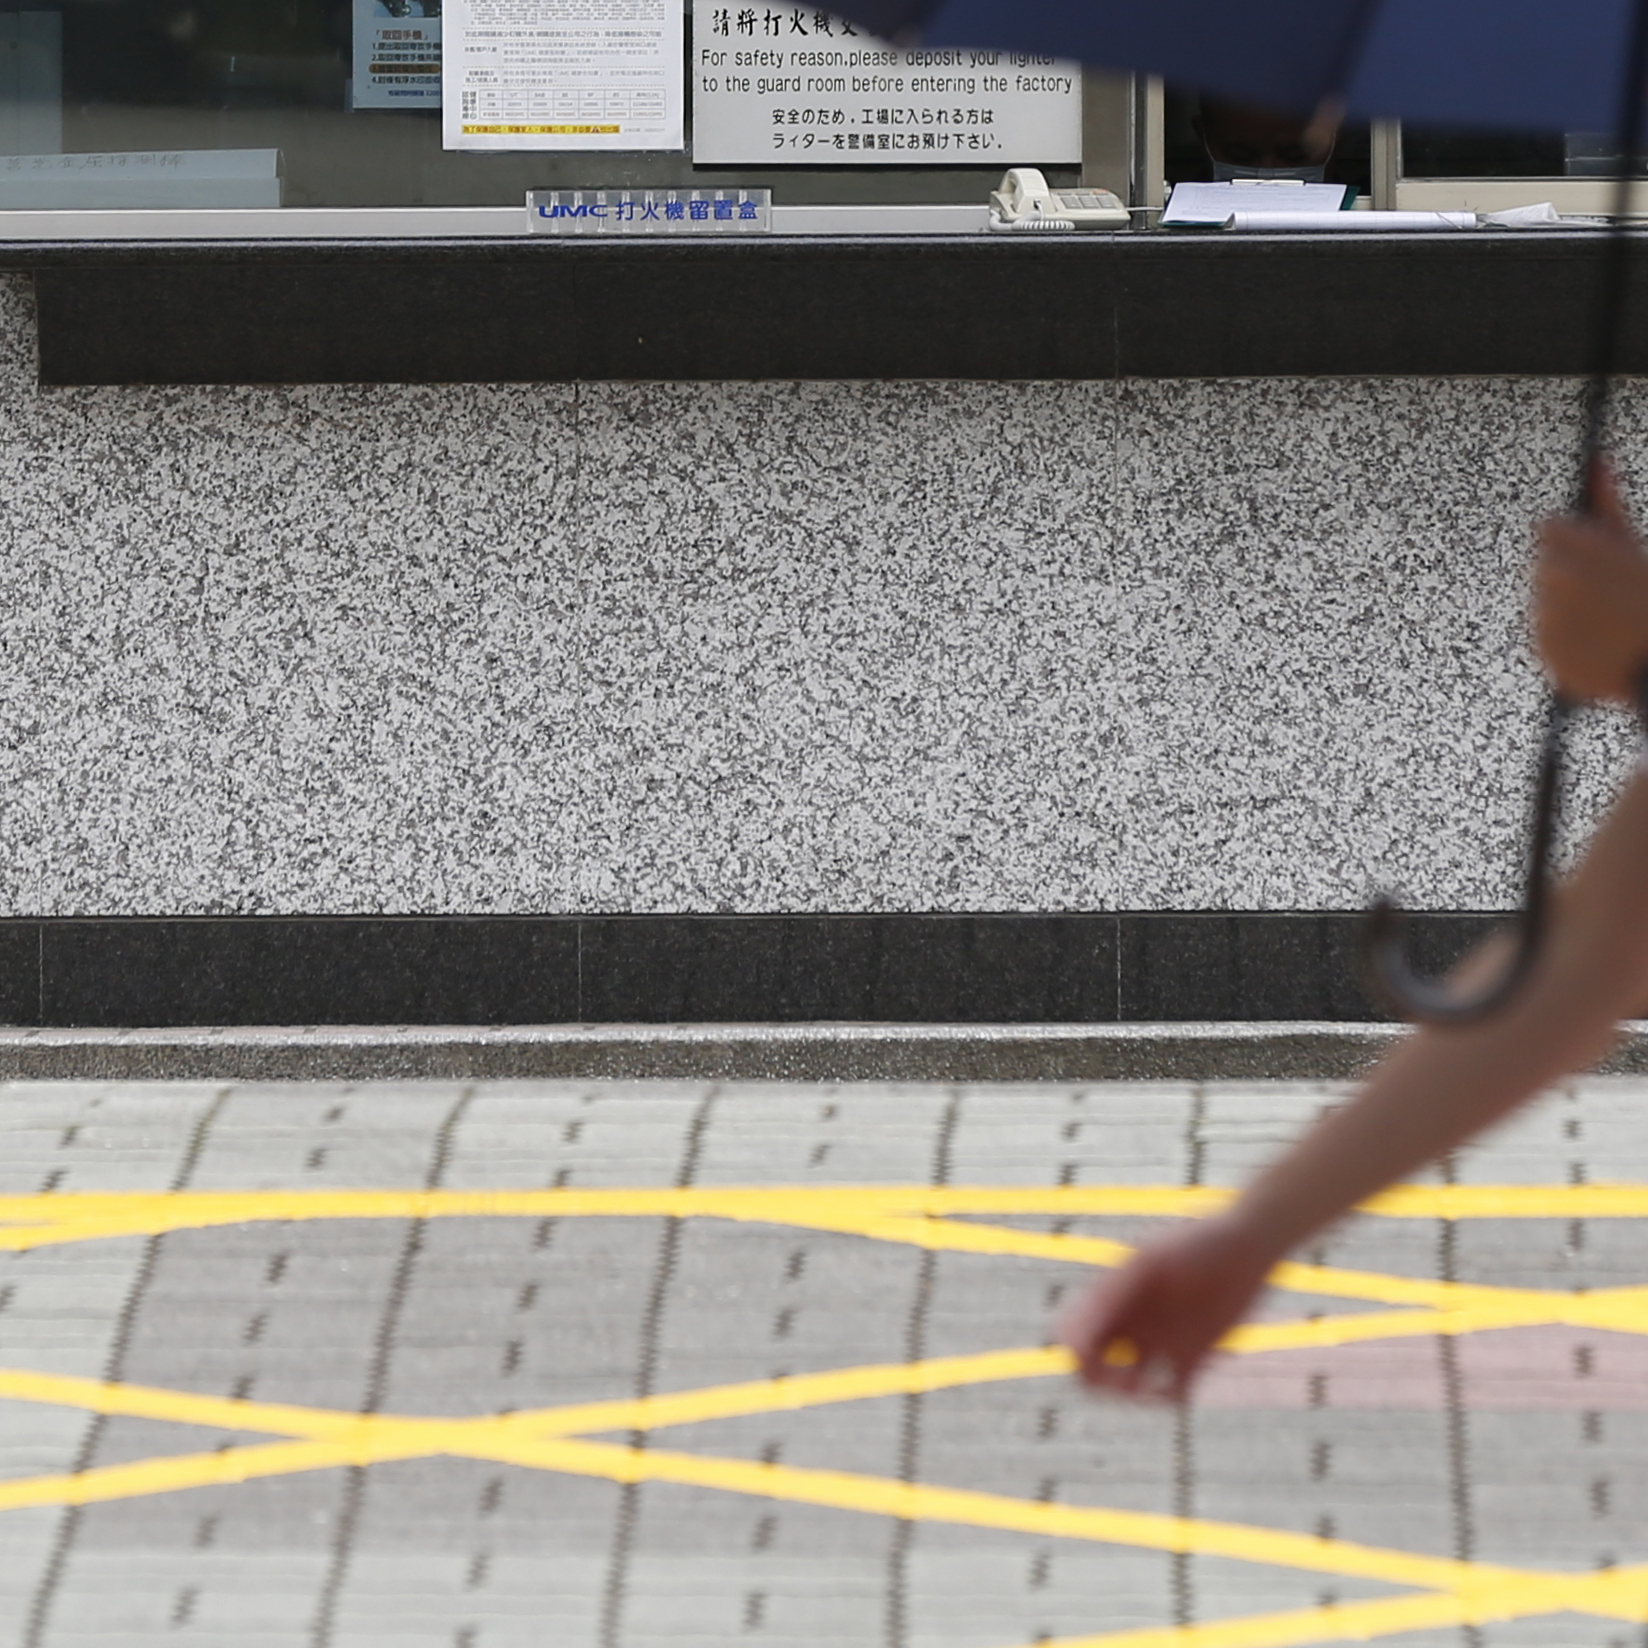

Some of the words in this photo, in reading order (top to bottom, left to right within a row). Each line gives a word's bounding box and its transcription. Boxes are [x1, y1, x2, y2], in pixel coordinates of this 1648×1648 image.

[712, 8, 877, 38] 請將打火機交
[702, 49, 727, 66] For
[734, 49, 784, 68] safety
[905, 50, 963, 68] deposit
[969, 52, 1001, 68] your
[702, 75, 718, 92] to
[725, 75, 750, 92] the
[757, 75, 801, 94] guard
[807, 79, 846, 92] room
[851, 74, 904, 92] before
[911, 75, 976, 94] entering
[982, 75, 1008, 92] the
[1016, 74, 1073, 94] factory
[539, 204, 609, 219] UMC
[615, 199, 759, 221] 打火機留置盒
